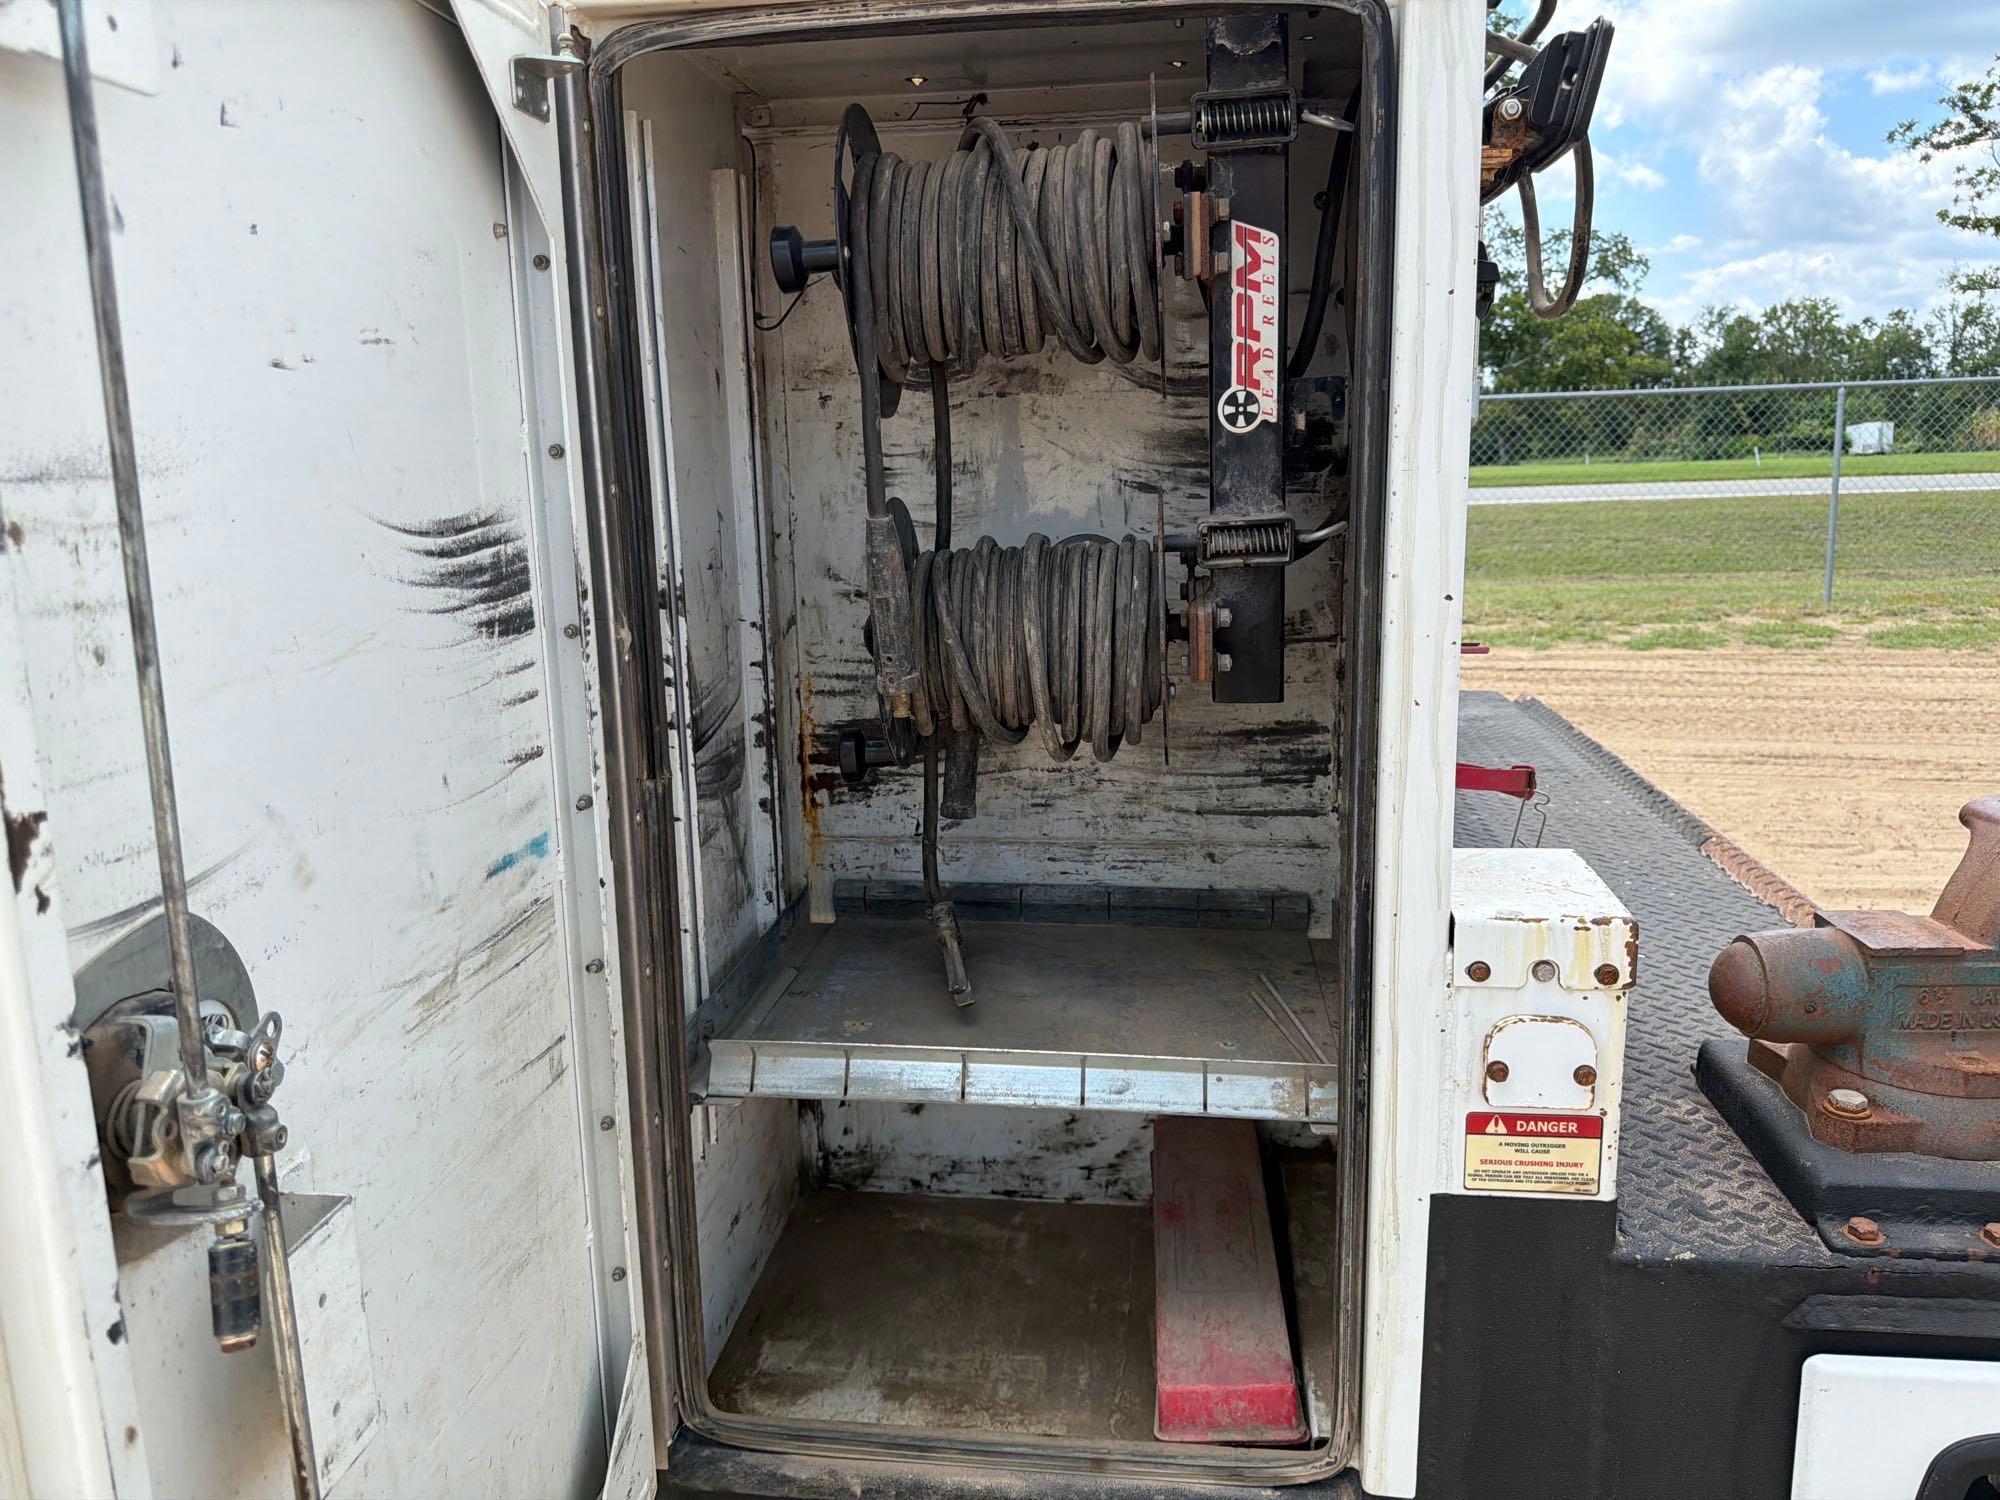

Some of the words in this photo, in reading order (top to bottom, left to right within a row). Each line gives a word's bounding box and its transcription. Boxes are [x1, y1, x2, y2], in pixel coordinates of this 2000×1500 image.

[1262, 235, 1275, 327] REELS
[1235, 224, 1262, 391] RPM
[1261, 347, 1275, 418] LEAD
[1970, 986, 2000, 1006] JA
[1898, 1010, 1953, 1030] MADE
[1958, 1009, 1977, 1030] IN
[1516, 1120, 1579, 1134] DANGER
[1514, 1160, 1553, 1168] CRUSHING
[1556, 1161, 1584, 1169] INJURY
